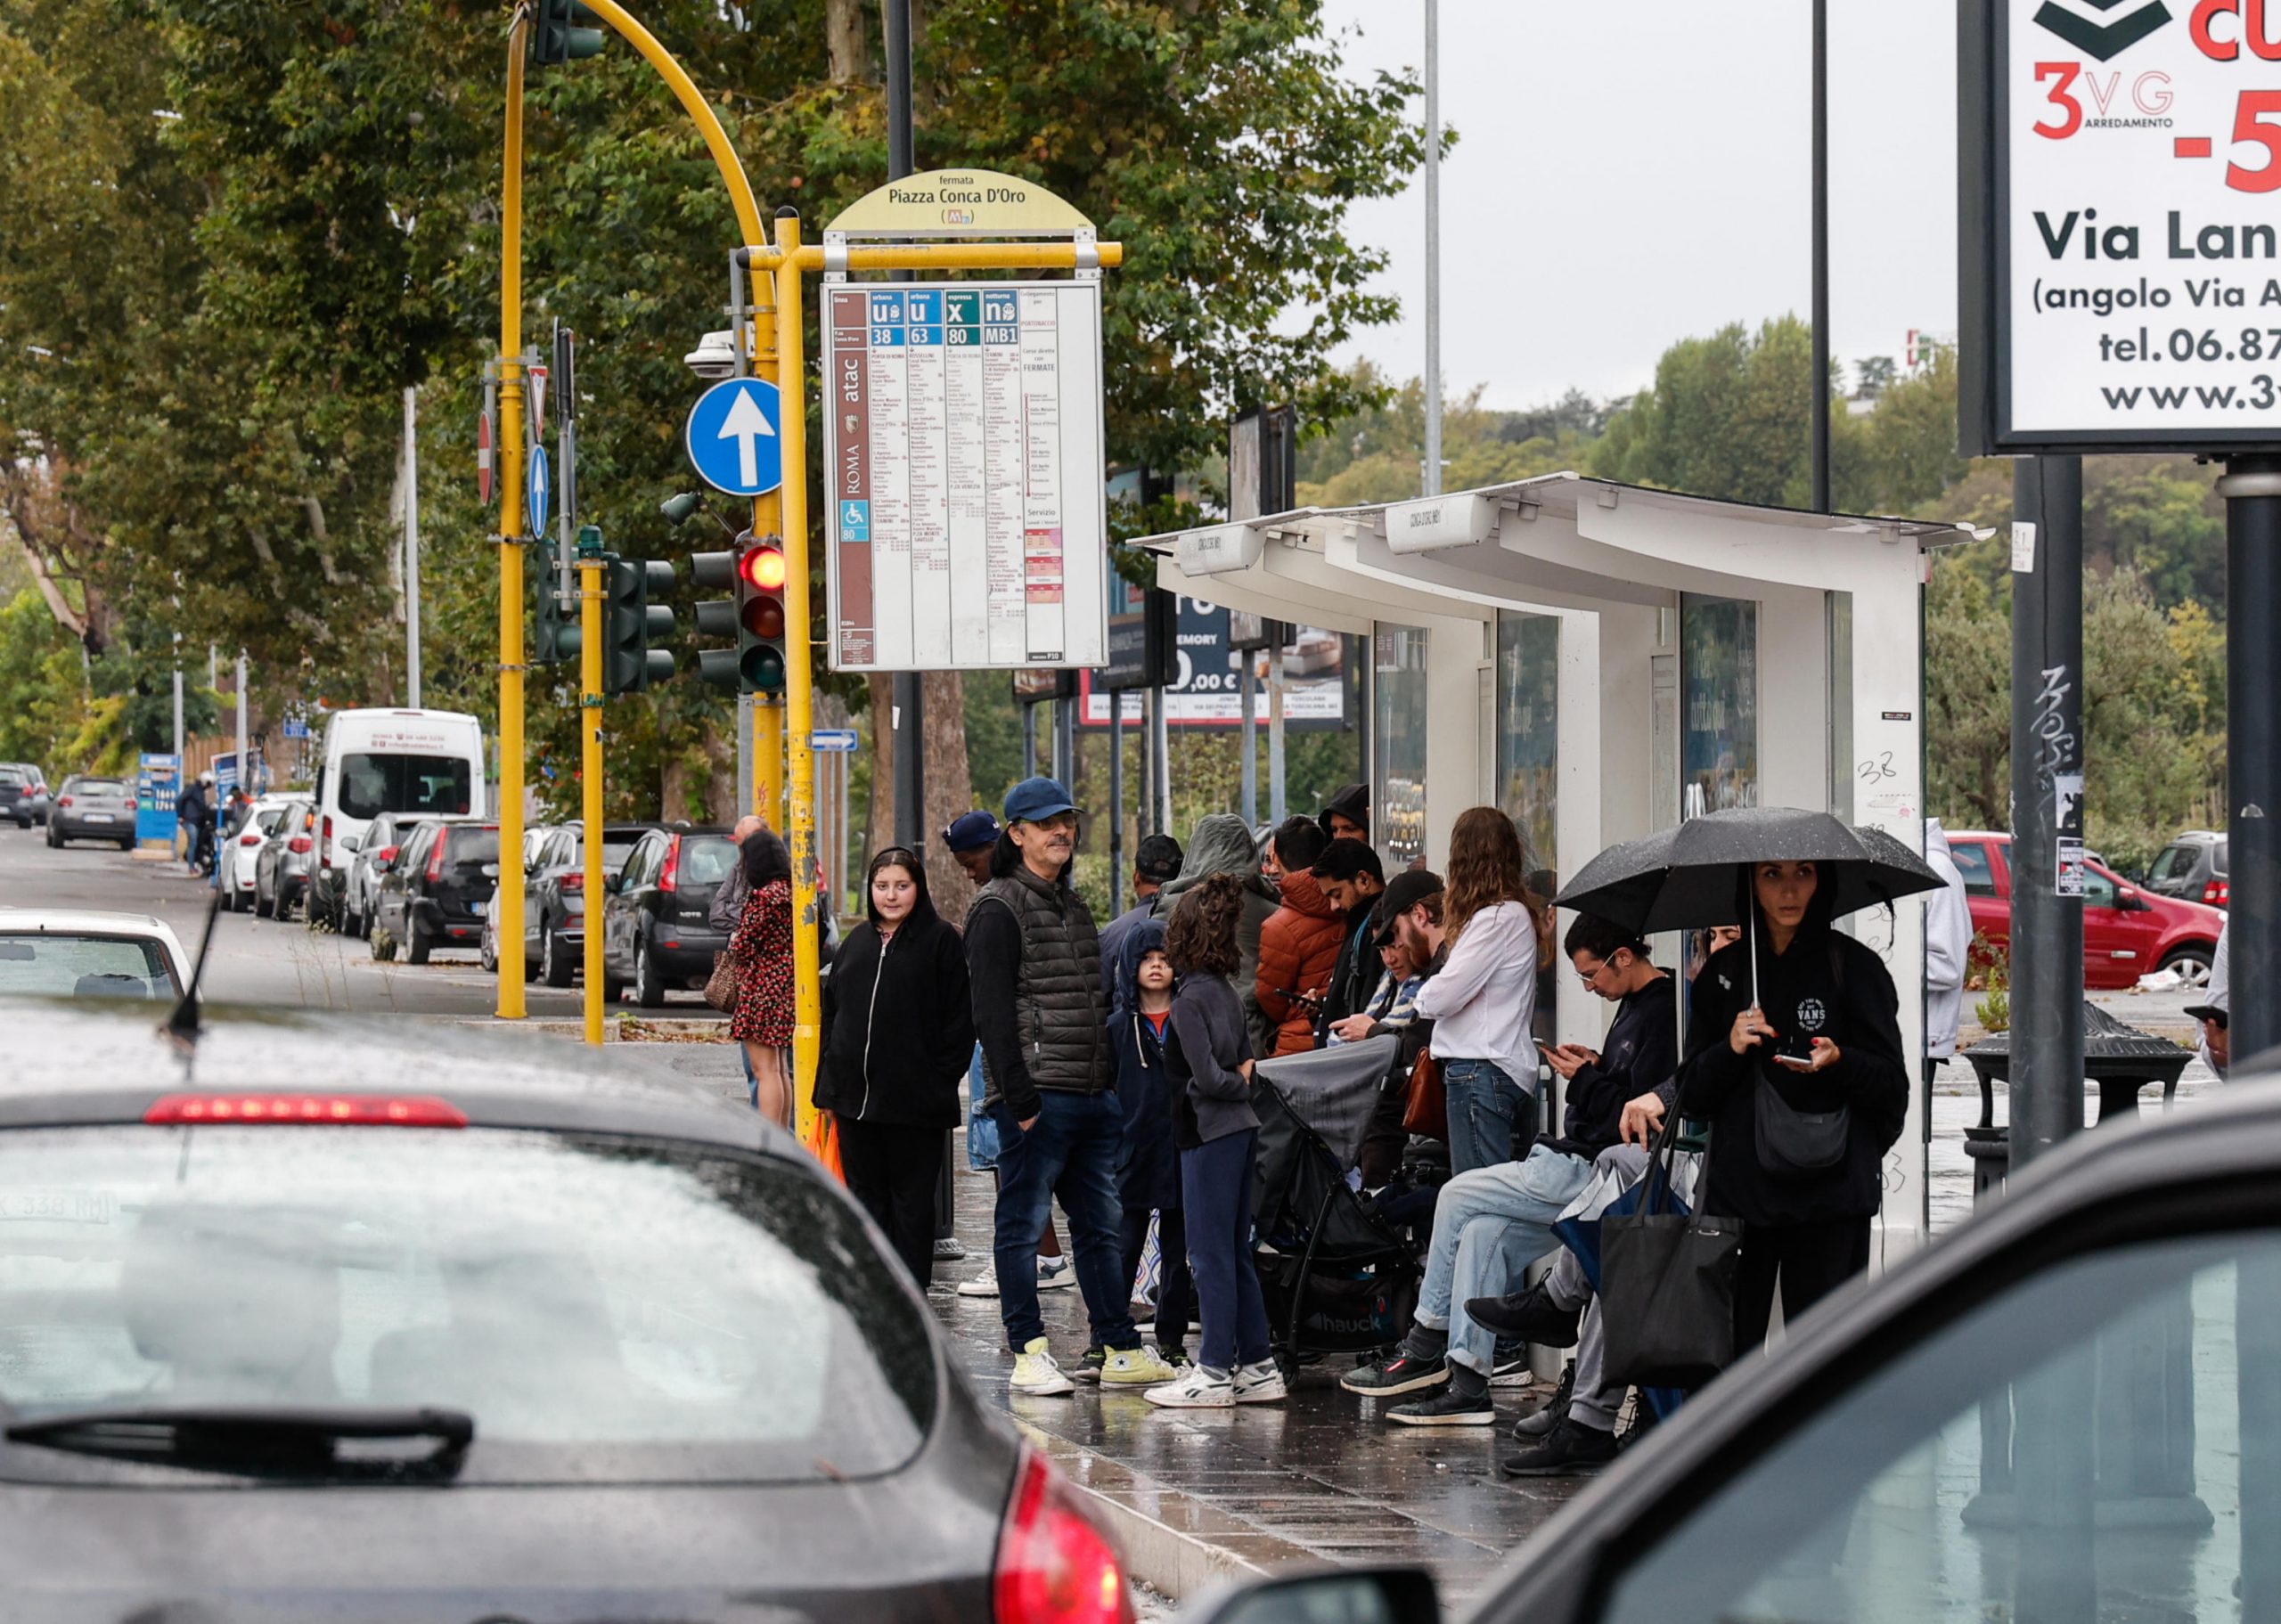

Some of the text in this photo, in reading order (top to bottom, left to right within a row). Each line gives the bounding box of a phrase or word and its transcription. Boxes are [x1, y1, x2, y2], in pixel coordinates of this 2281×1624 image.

[2084, 118, 2173, 128] ARREDAMENTO
[939, 175, 974, 185] fermata
[889, 187, 1026, 204] Piazza Conca D'Oro
[2032, 208, 2277, 260] Via Lan
[2033, 277, 2171, 316] (angolo
[2184, 278, 2244, 307] Via
[873, 304, 887, 322] u
[911, 303, 926, 322] u
[873, 329, 892, 345] 38
[911, 328, 928, 344] 63
[948, 329, 968, 344] 80
[985, 327, 1018, 344] MB1
[1024, 363, 1055, 372] FERMATE
[842, 358, 859, 403] atac
[2101, 374, 2281, 410] www.3
[846, 444, 860, 494] ROMA
[1027, 509, 1056, 517] Servizio
[842, 529, 855, 540] 80
[1176, 633, 1218, 646] EMORY
[1796, 1008, 1826, 1021] VANS
[1320, 1312, 1381, 1334] hauck
